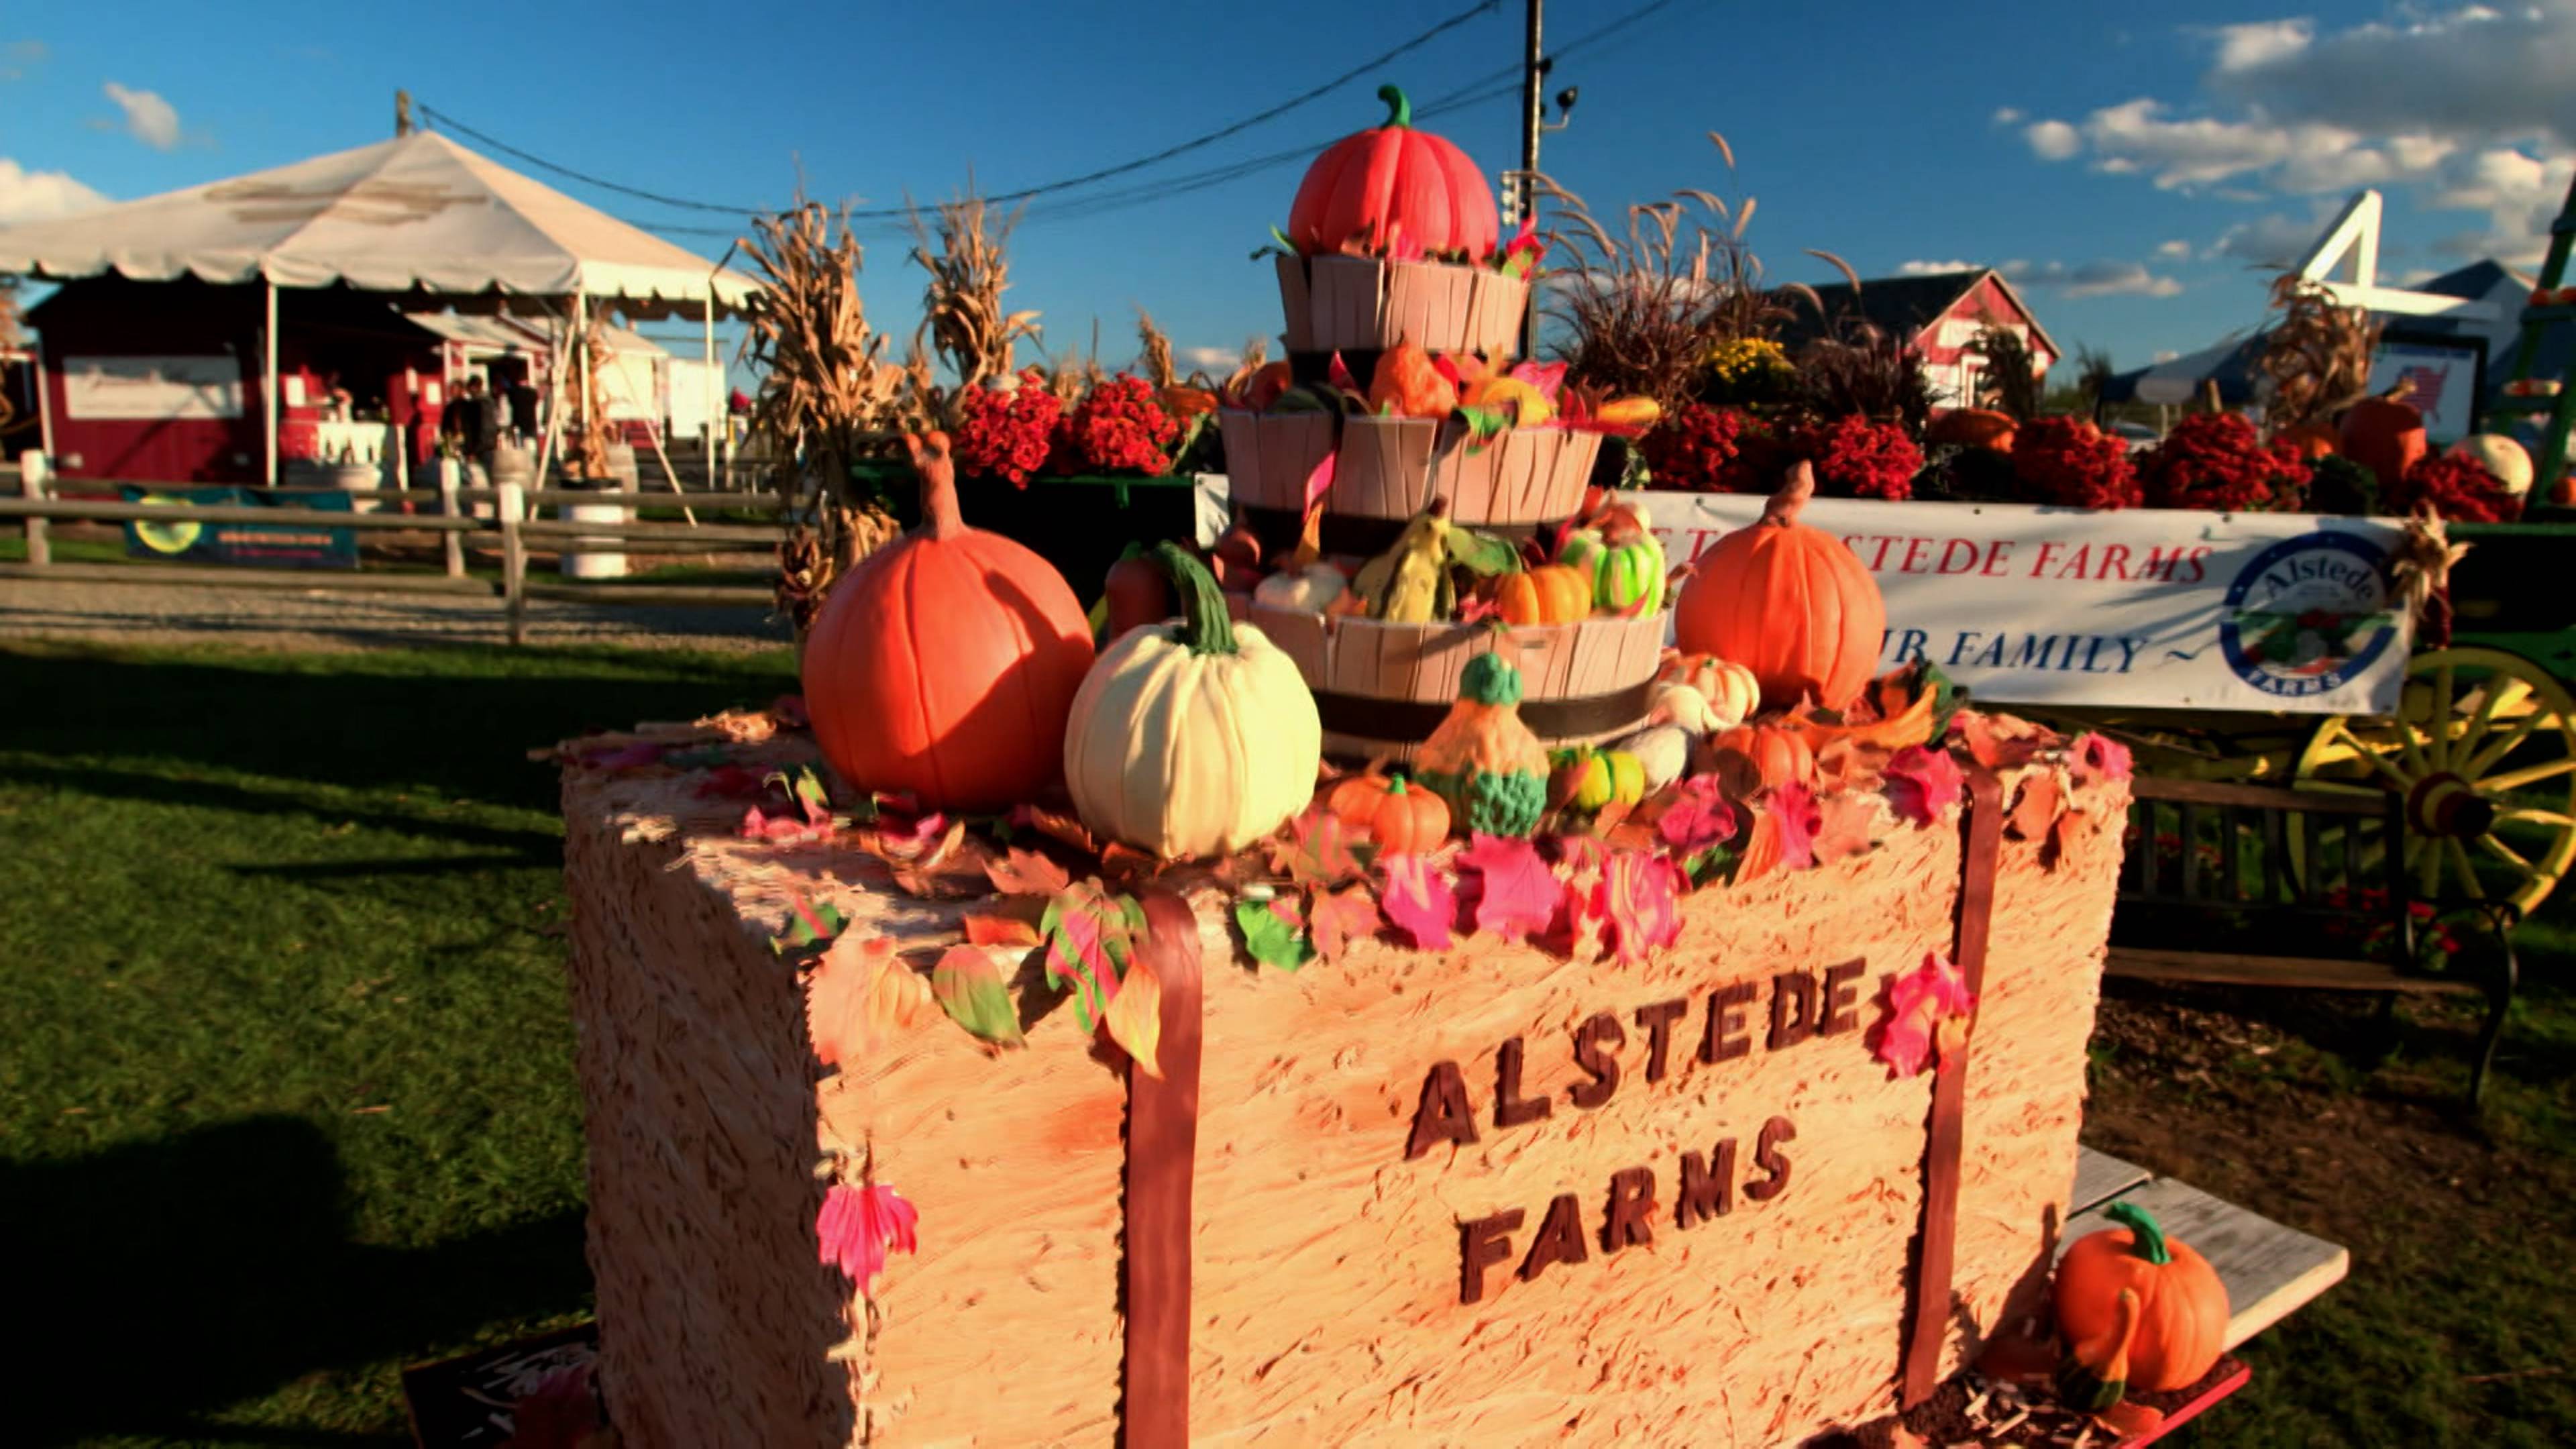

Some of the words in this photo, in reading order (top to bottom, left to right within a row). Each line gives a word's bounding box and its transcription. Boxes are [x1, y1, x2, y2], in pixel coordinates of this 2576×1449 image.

[2029, 541, 2214, 584] FARMS
[2263, 555, 2375, 600] Alstede
[1944, 631, 2150, 674] FAMILY
[1403, 956, 1866, 1161] ALSTEDE
[1454, 1115, 1797, 1305] FARMS
